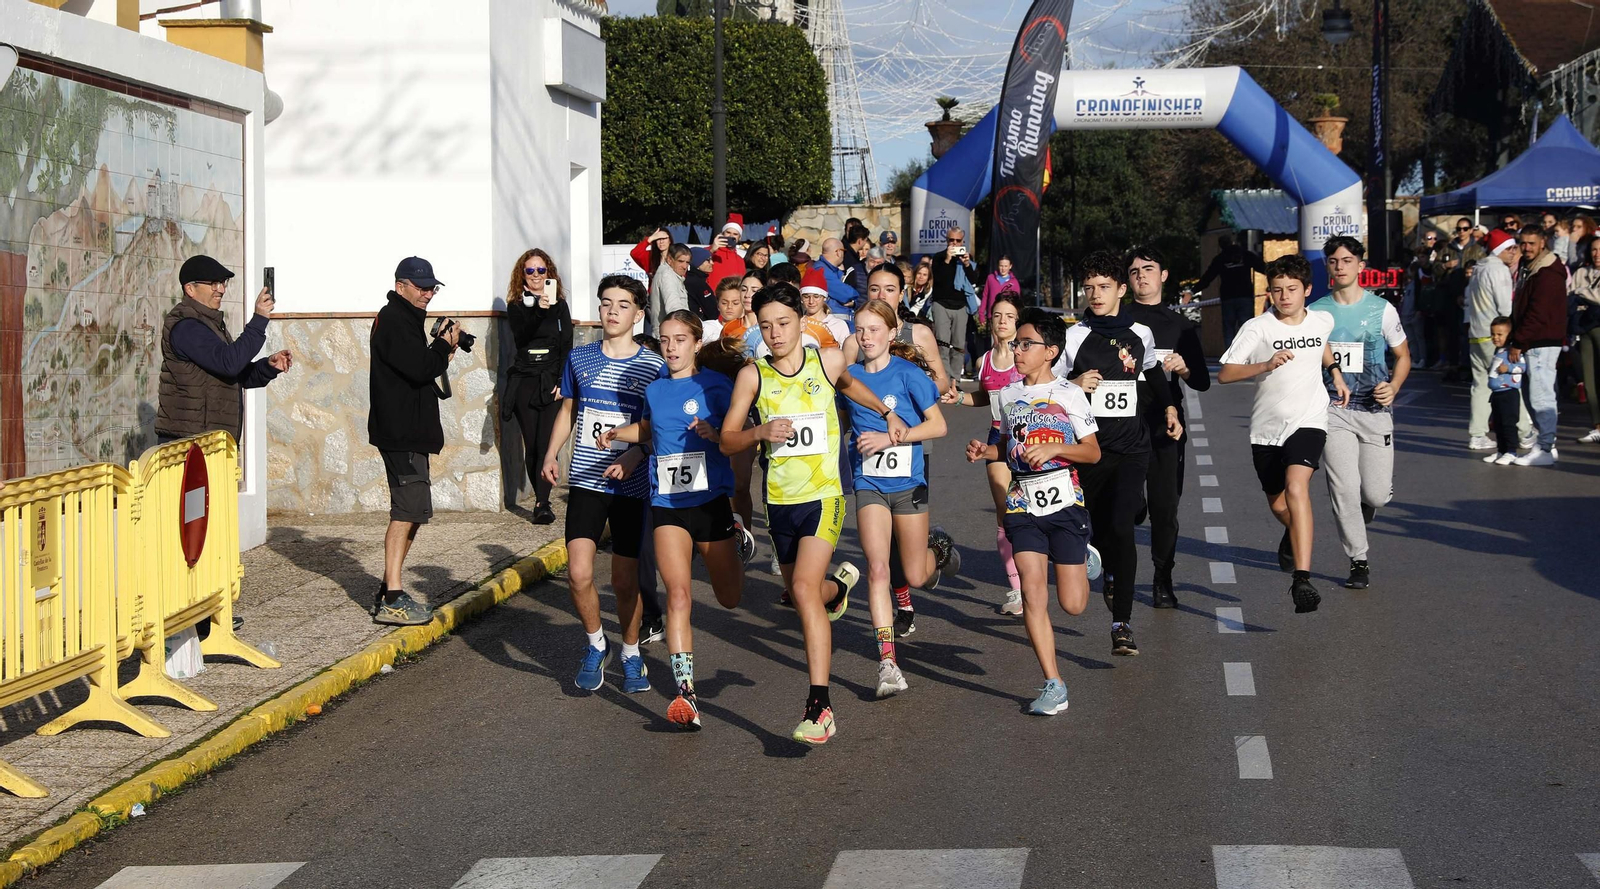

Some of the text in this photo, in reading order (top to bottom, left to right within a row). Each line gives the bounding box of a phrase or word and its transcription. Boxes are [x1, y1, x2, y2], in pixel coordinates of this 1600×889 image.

[1018, 70, 1054, 156] Running
[1076, 98, 1202, 116] CRONOFINISHER
[1000, 108, 1022, 178] Turismo
[1323, 215, 1352, 225] CRONO
[1273, 336, 1322, 350] adidas
[1333, 352, 1350, 366] 91
[1105, 392, 1128, 409] 85
[786, 426, 813, 448] 90
[874, 452, 898, 469] 76
[667, 466, 692, 485] 75
[1035, 487, 1062, 508] 82
